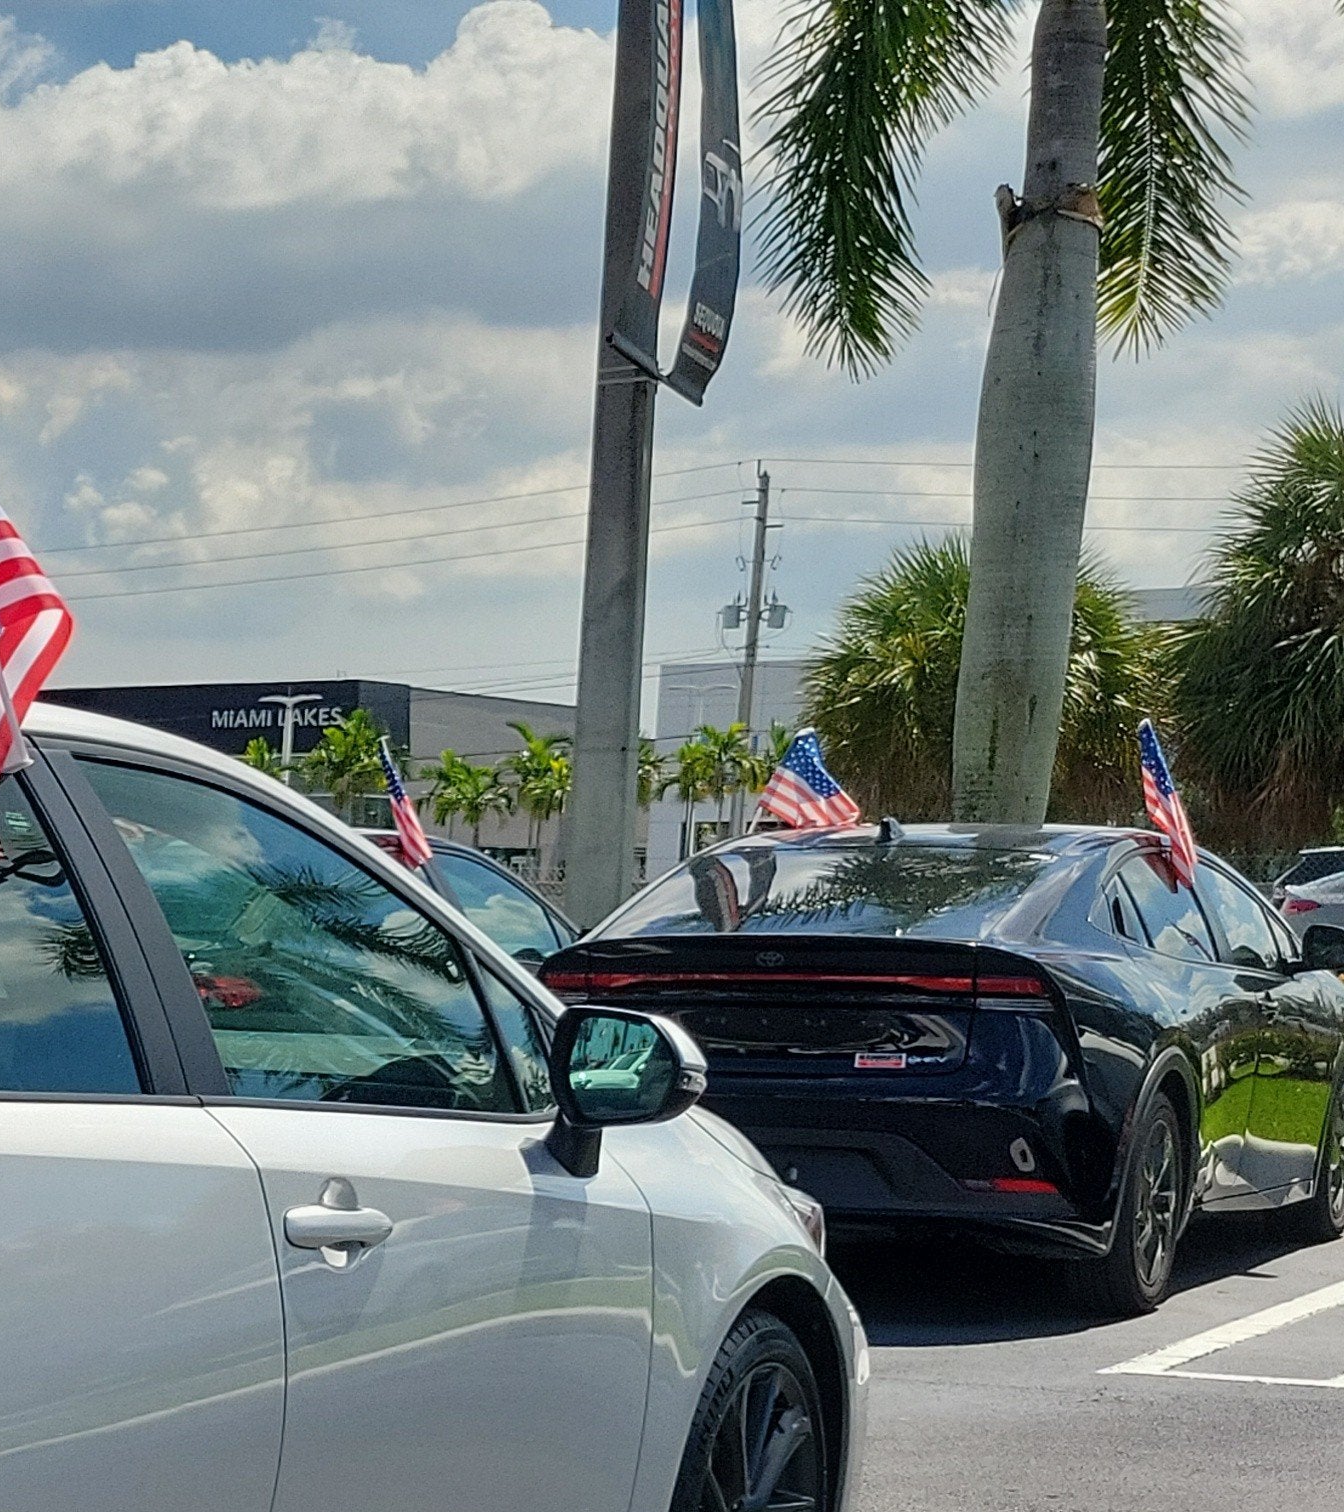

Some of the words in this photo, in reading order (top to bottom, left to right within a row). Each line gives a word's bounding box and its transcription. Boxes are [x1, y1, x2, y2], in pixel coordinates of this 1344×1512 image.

[637, 0, 669, 291] HEADQUA
[212, 708, 272, 728] MIAMI
[277, 707, 344, 726] LAKES
